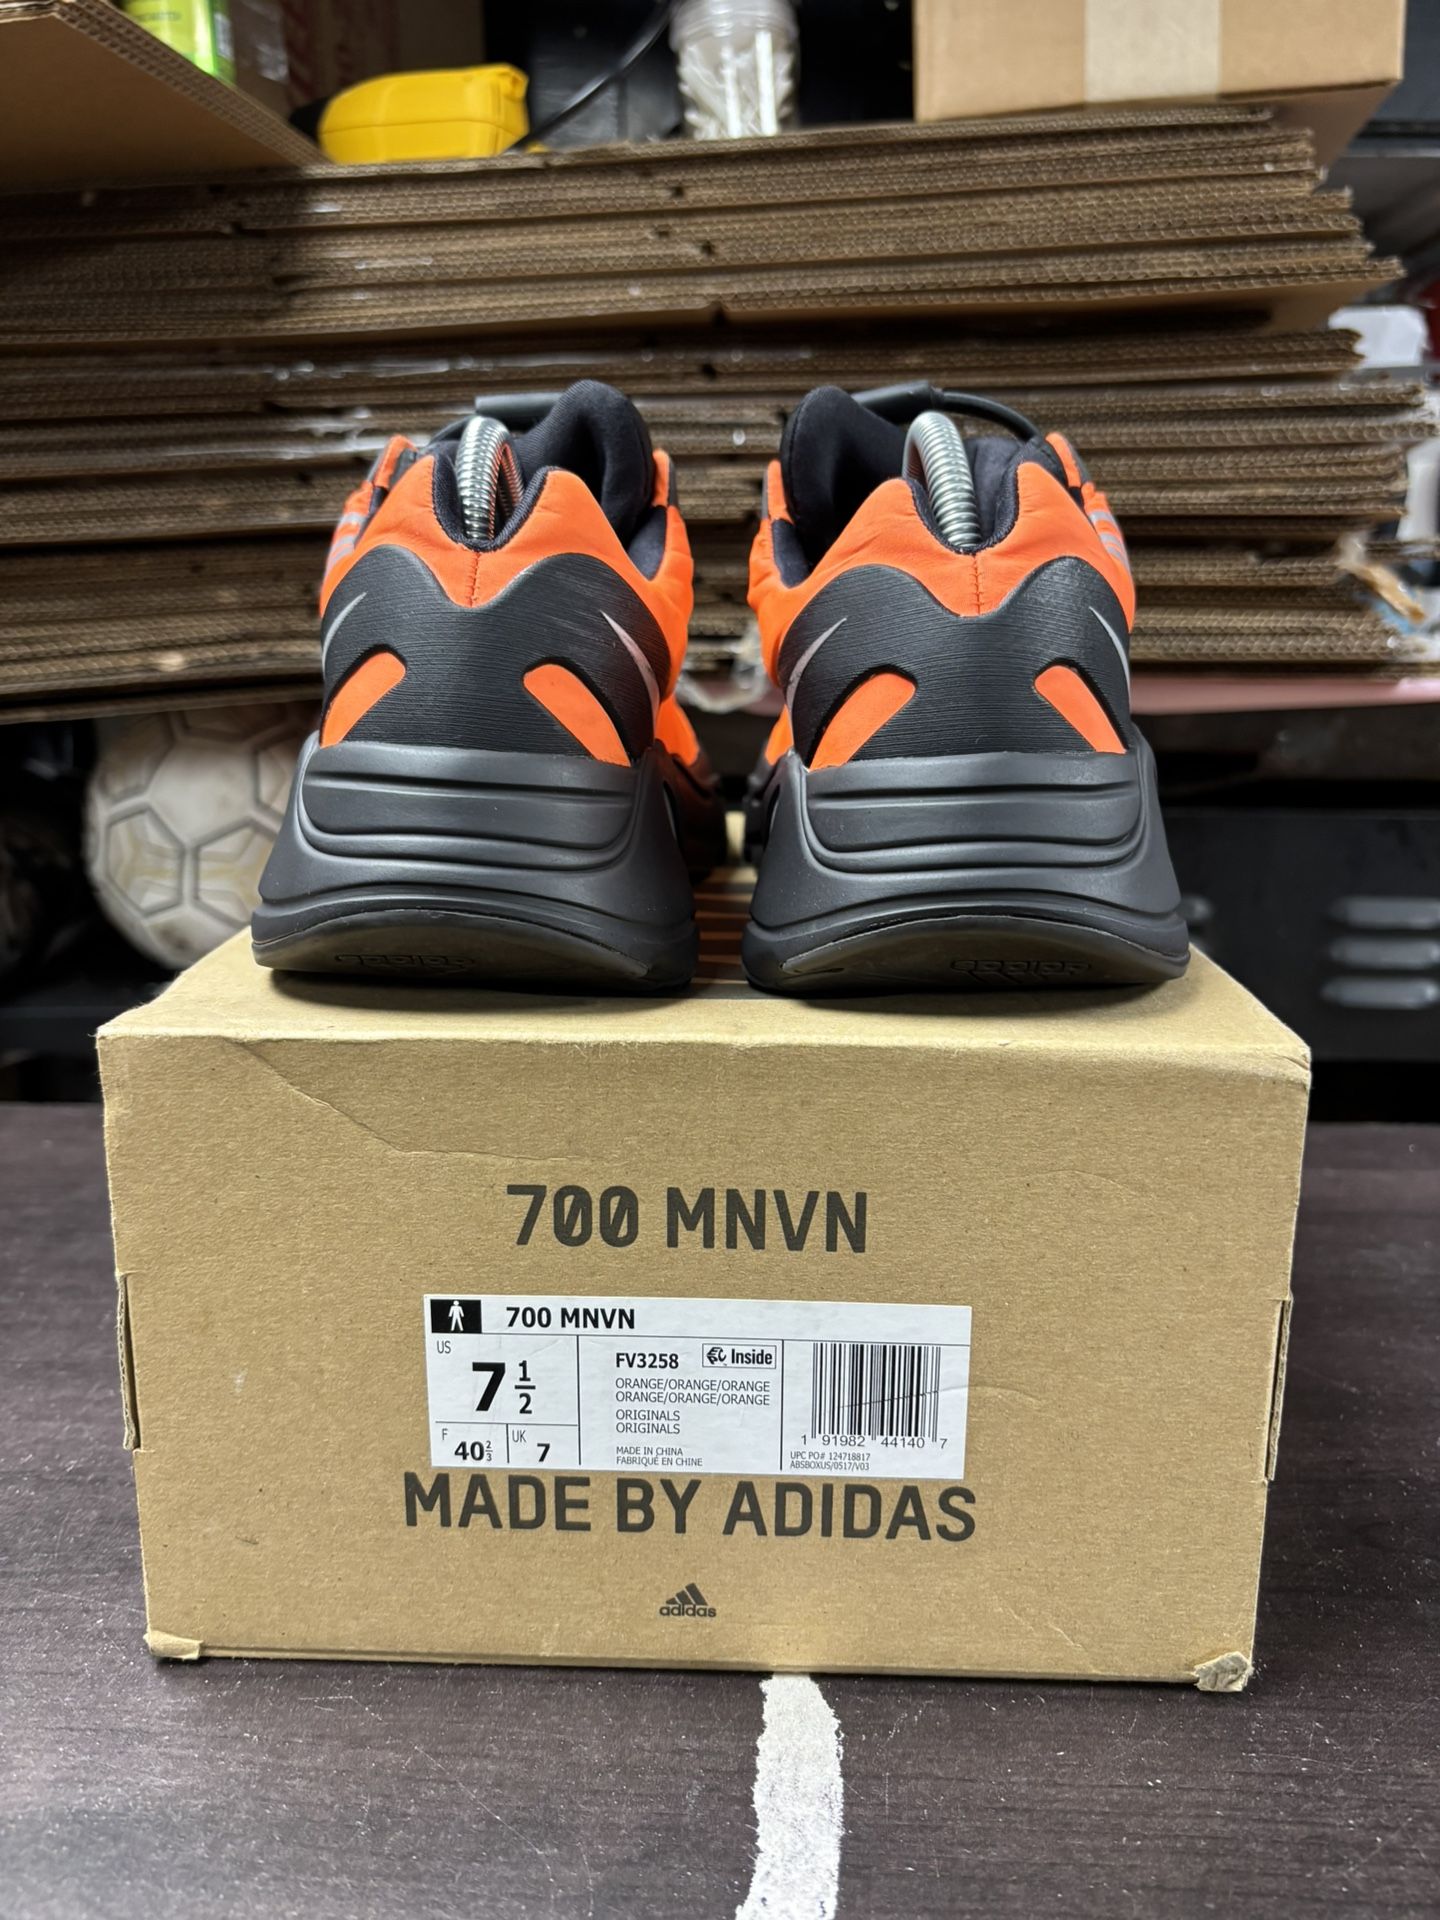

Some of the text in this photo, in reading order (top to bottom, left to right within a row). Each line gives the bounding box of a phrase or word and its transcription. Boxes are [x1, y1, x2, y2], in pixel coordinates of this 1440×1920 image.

[507, 1184, 867, 1253] 700 MNVN
[506, 1307, 634, 1329] 700 MNVN
[437, 1341, 451, 1354] US
[616, 1353, 678, 1369] FV3258
[732, 1349, 772, 1364] Inside
[472, 1362, 505, 1411] 7
[616, 1378, 770, 1392] ORANGE/ORANGE/ORANGE
[616, 1391, 770, 1406] ORANGE/ORANGE/ORANGE
[616, 1409, 680, 1421] ORIGINALS
[442, 1428, 448, 1440] F
[616, 1422, 680, 1434] ORIGINALS
[511, 1430, 527, 1443] UK
[801, 1434, 948, 1449] 1 91982 44140 7
[455, 1442, 484, 1461] 40
[537, 1443, 550, 1462] 7
[616, 1446, 684, 1456] MADE IN CHINA
[790, 1451, 806, 1460] UPC
[809, 1451, 825, 1460] PO#
[662, 1457, 673, 1465] EN
[675, 1457, 703, 1467] CHINE
[404, 1472, 976, 1542] MADE BY ADIDAS
[659, 1604, 717, 1618] adidas
